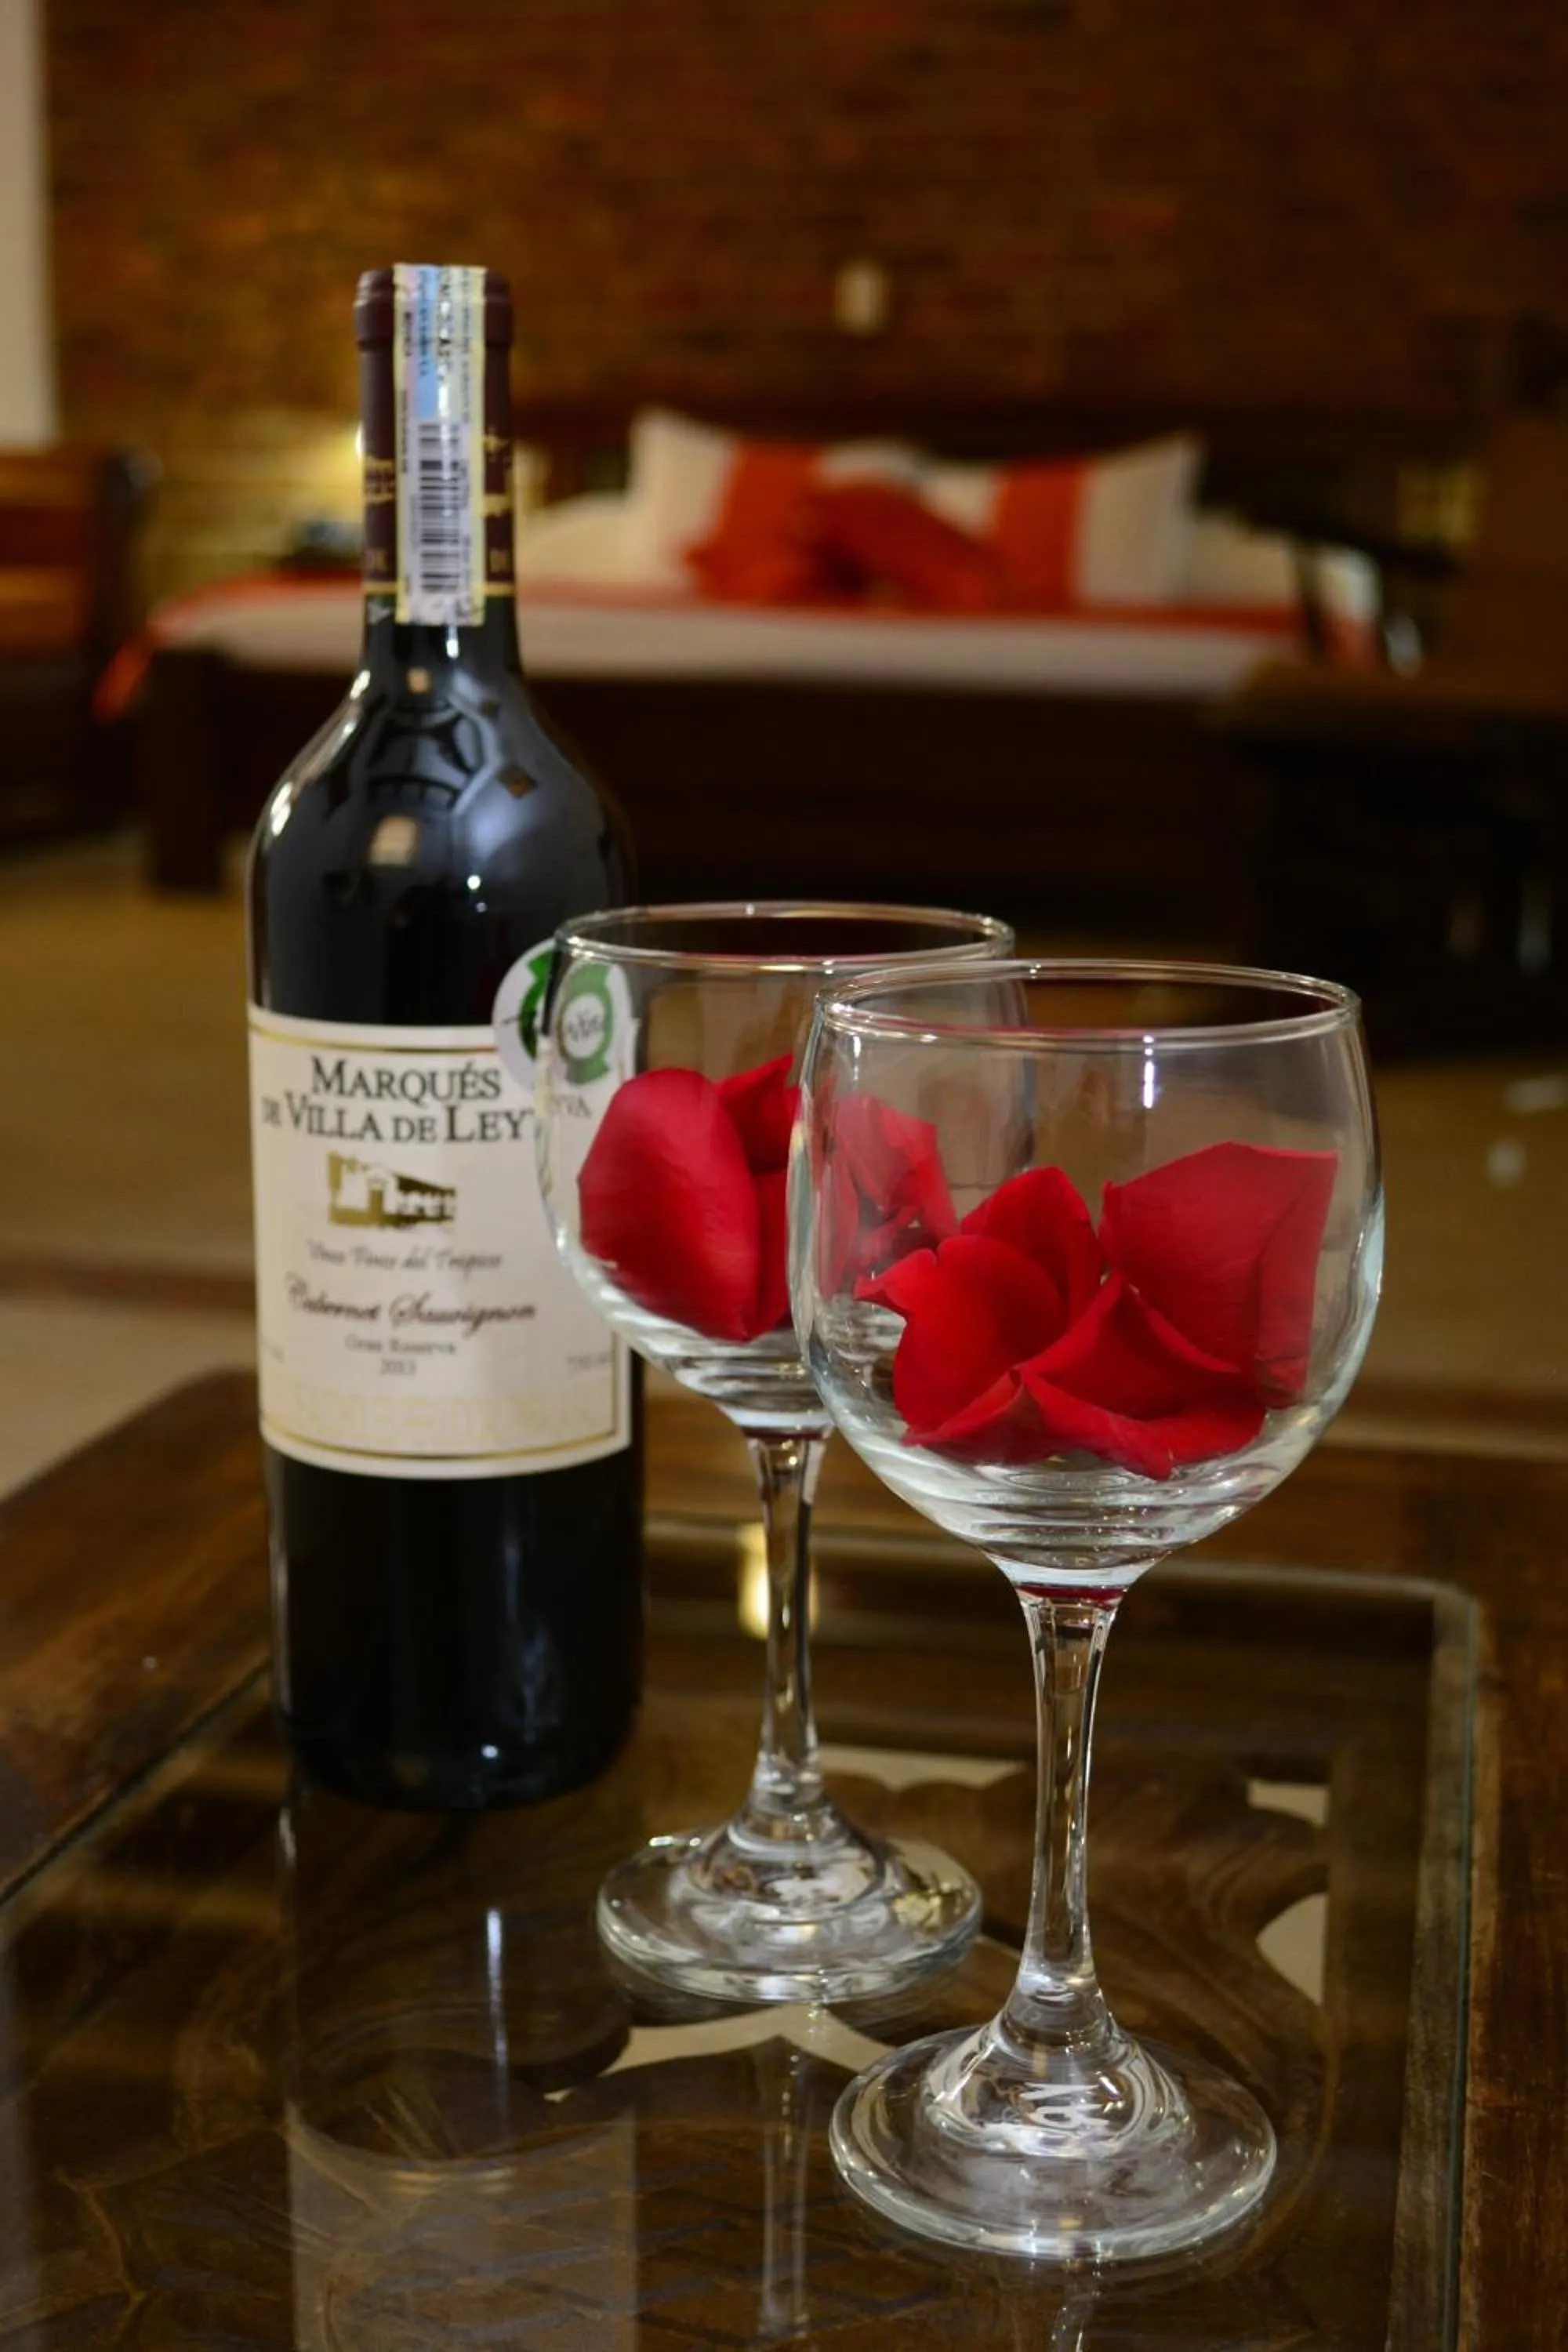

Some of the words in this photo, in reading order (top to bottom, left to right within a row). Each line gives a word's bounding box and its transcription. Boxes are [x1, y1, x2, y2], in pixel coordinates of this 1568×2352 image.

[310, 1055, 502, 1105] MARQUÉS
[285, 1091, 383, 1142] VILLA
[392, 1116, 437, 1142] DE
